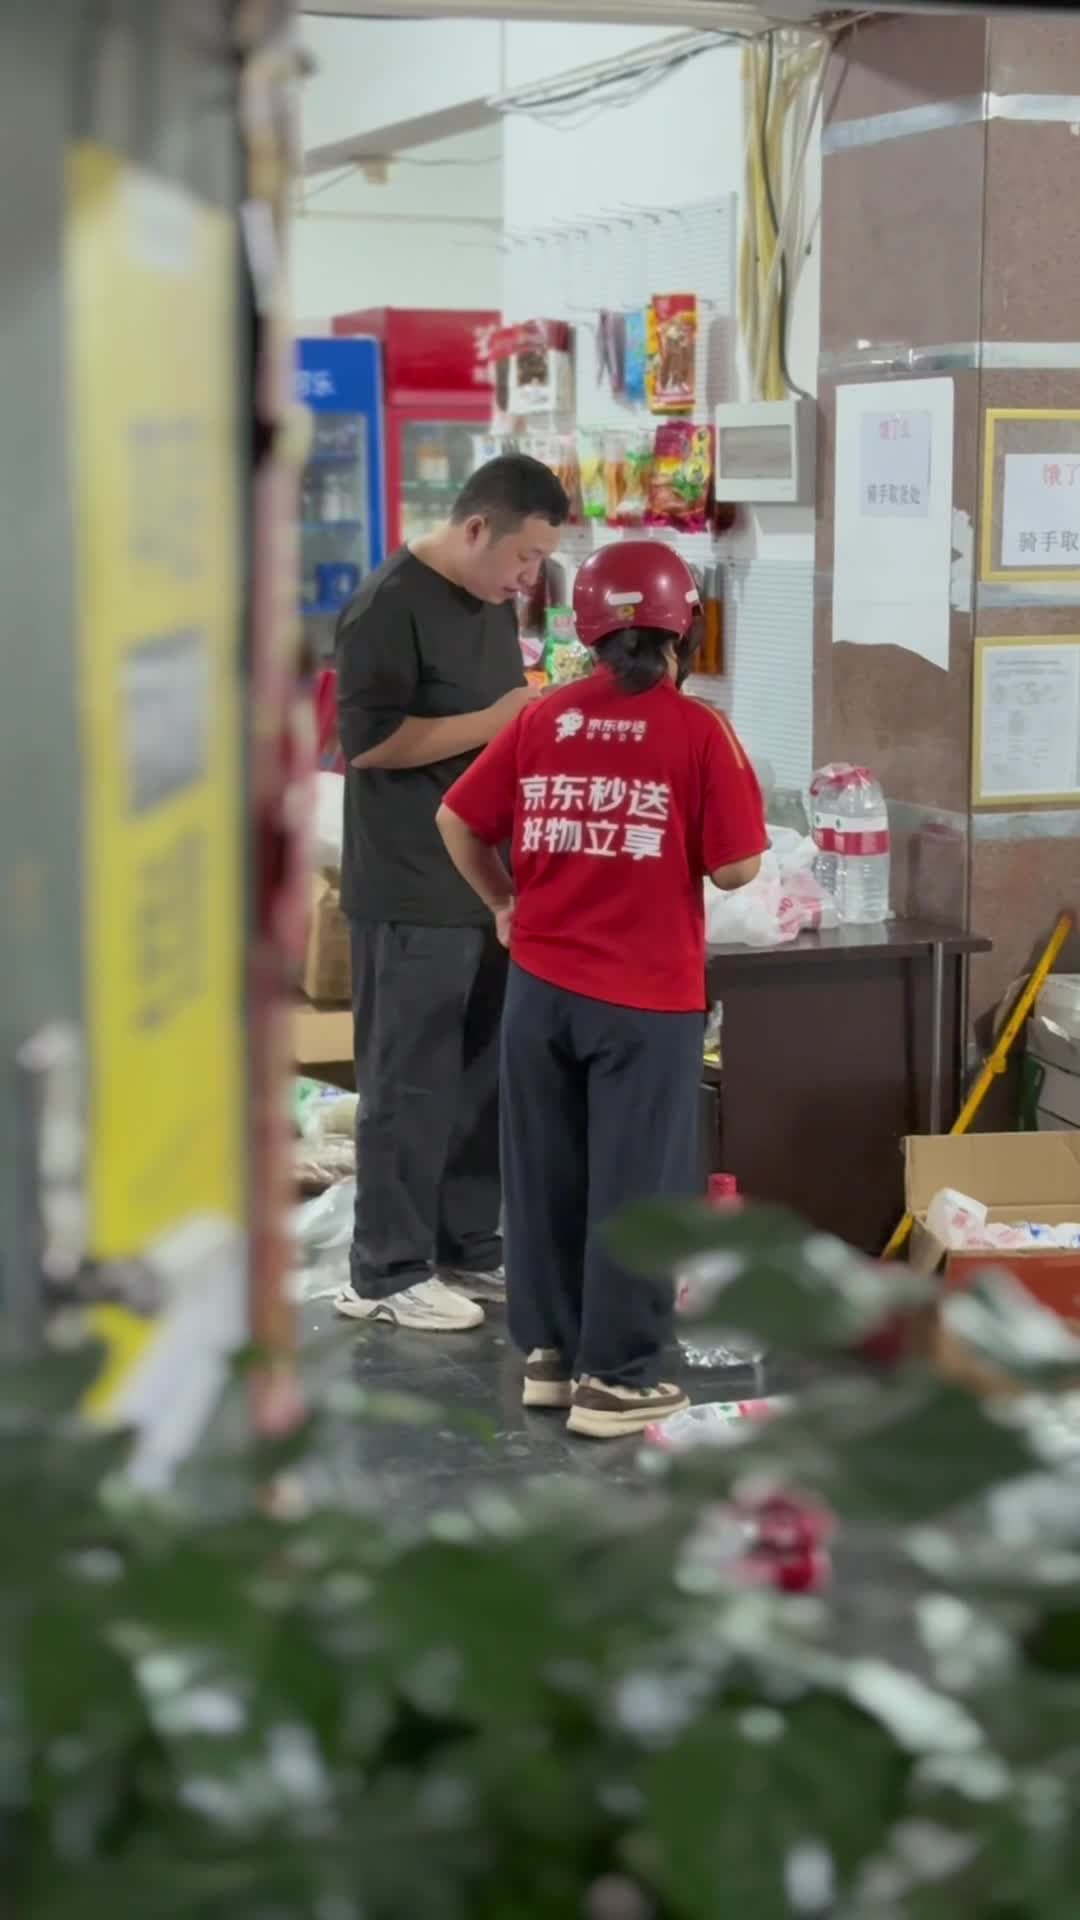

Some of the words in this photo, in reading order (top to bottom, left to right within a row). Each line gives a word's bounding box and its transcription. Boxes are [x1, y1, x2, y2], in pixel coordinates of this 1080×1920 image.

[1018, 530, 1080, 553] 骑手取
[588, 718, 647, 733] 京东秒送
[520, 774, 670, 821] 京东秒送
[521, 816, 665, 861] 好物立享
